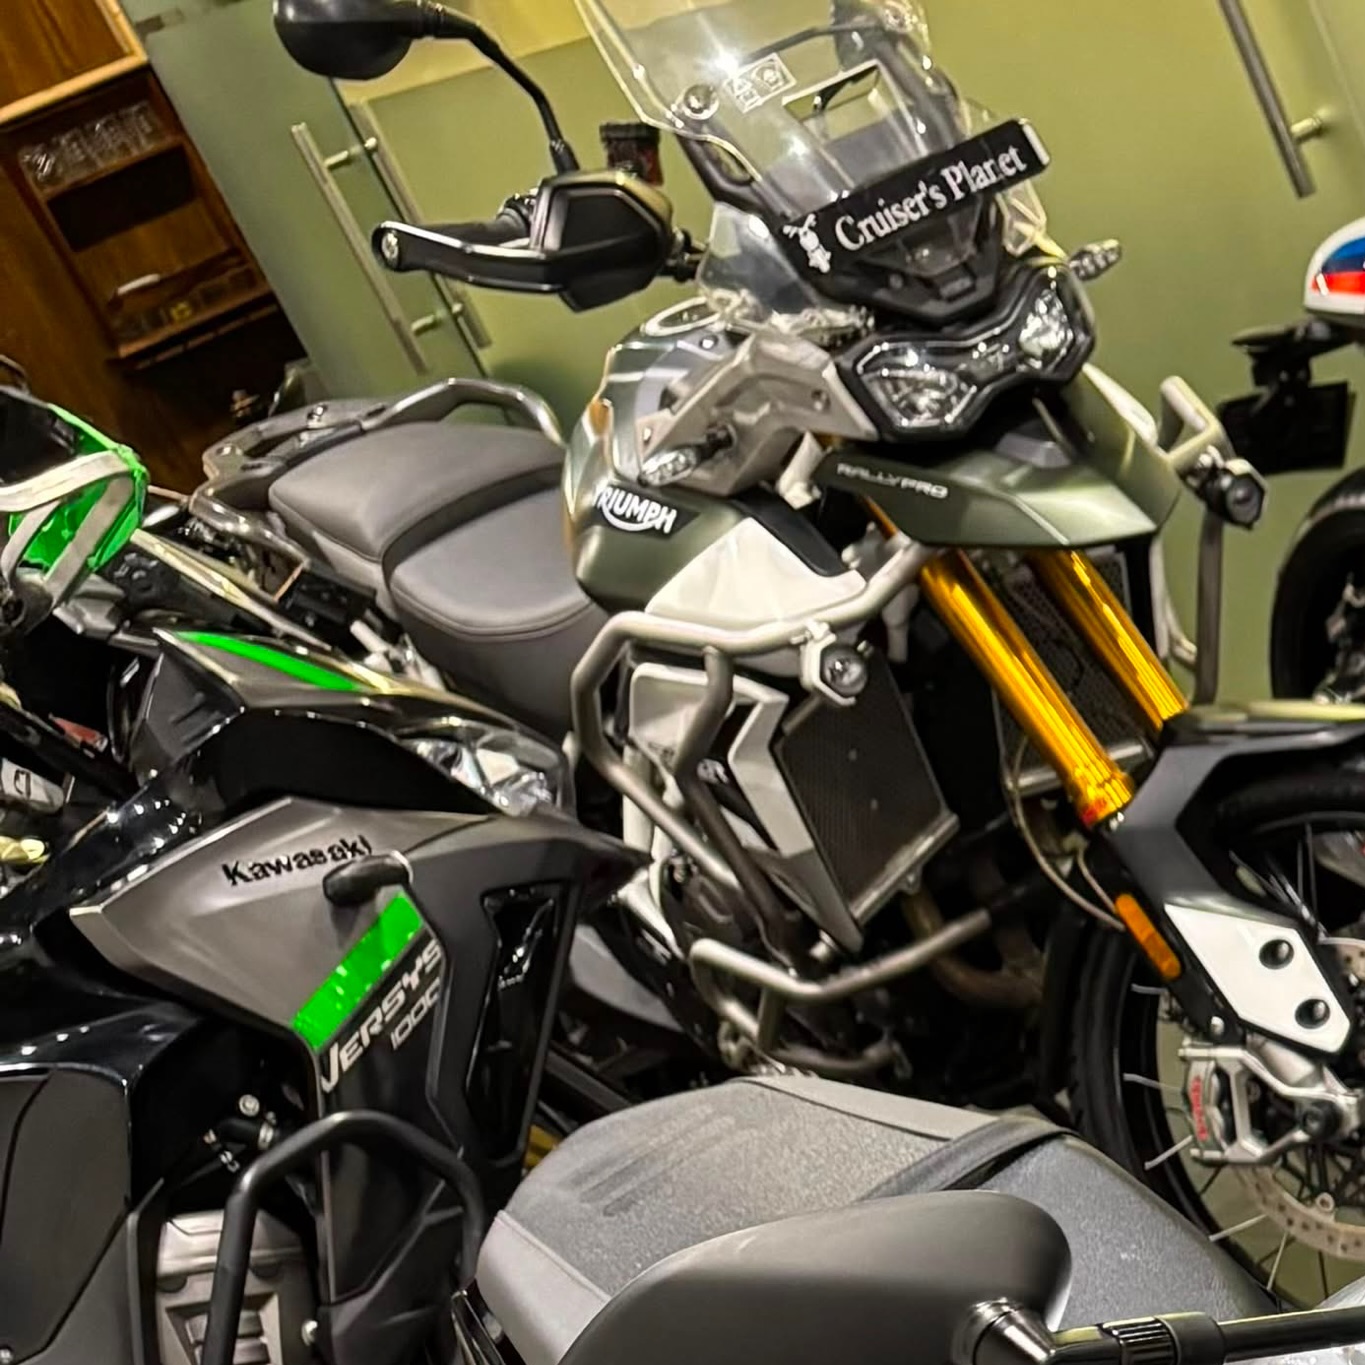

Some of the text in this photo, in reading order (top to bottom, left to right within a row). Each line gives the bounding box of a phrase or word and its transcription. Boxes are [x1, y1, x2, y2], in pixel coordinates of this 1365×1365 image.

[835, 144, 1028, 251] Cruiser's Planet
[222, 834, 372, 887] Kawasaki
[321, 938, 442, 1093] VERSYS
